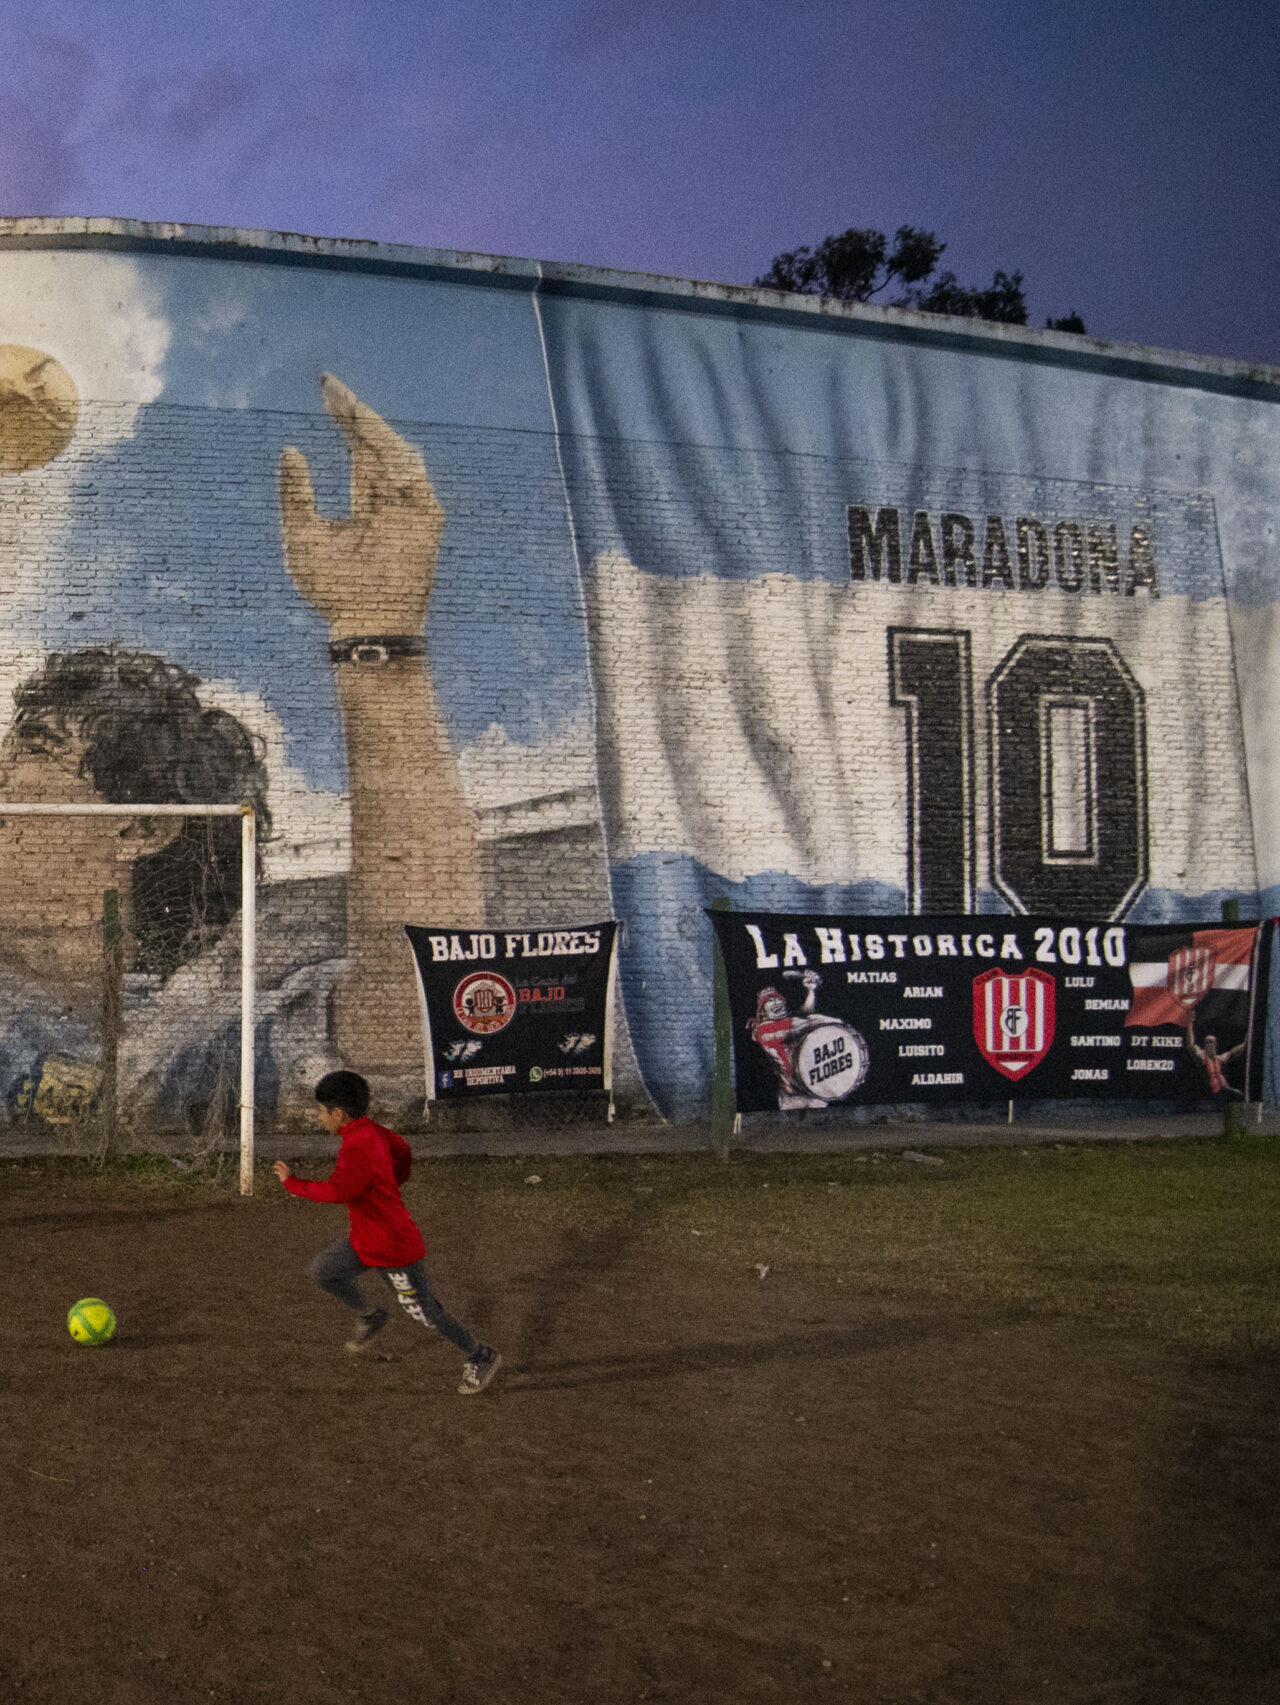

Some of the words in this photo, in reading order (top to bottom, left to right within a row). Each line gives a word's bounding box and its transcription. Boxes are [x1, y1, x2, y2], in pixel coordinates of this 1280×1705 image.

[847, 505, 1160, 599] MARADONA
[886, 625, 1150, 922] 10
[428, 933, 496, 962] BAJO
[504, 930, 602, 959] FLORES
[745, 924, 807, 968] LA
[814, 927, 1023, 963] HISTORICA
[1034, 926, 1126, 967] 2010
[847, 972, 897, 984] MATIAS
[1065, 977, 1095, 988] LULU
[518, 986, 565, 1003] BAJO
[903, 987, 943, 998] ARIAN
[1084, 999, 1130, 1011] DEMIAN
[879, 1018, 932, 1030] MAXIMO
[1070, 1035, 1121, 1047] SANTINO
[1131, 1036, 1148, 1047] DT
[1151, 1036, 1183, 1047] KIKE
[813, 1036, 846, 1065] BAJO
[898, 1045, 945, 1057] LUISITO
[808, 1052, 853, 1086] FLORES
[1126, 1059, 1174, 1071] LORENZO
[1071, 1069, 1109, 1081] JONAS
